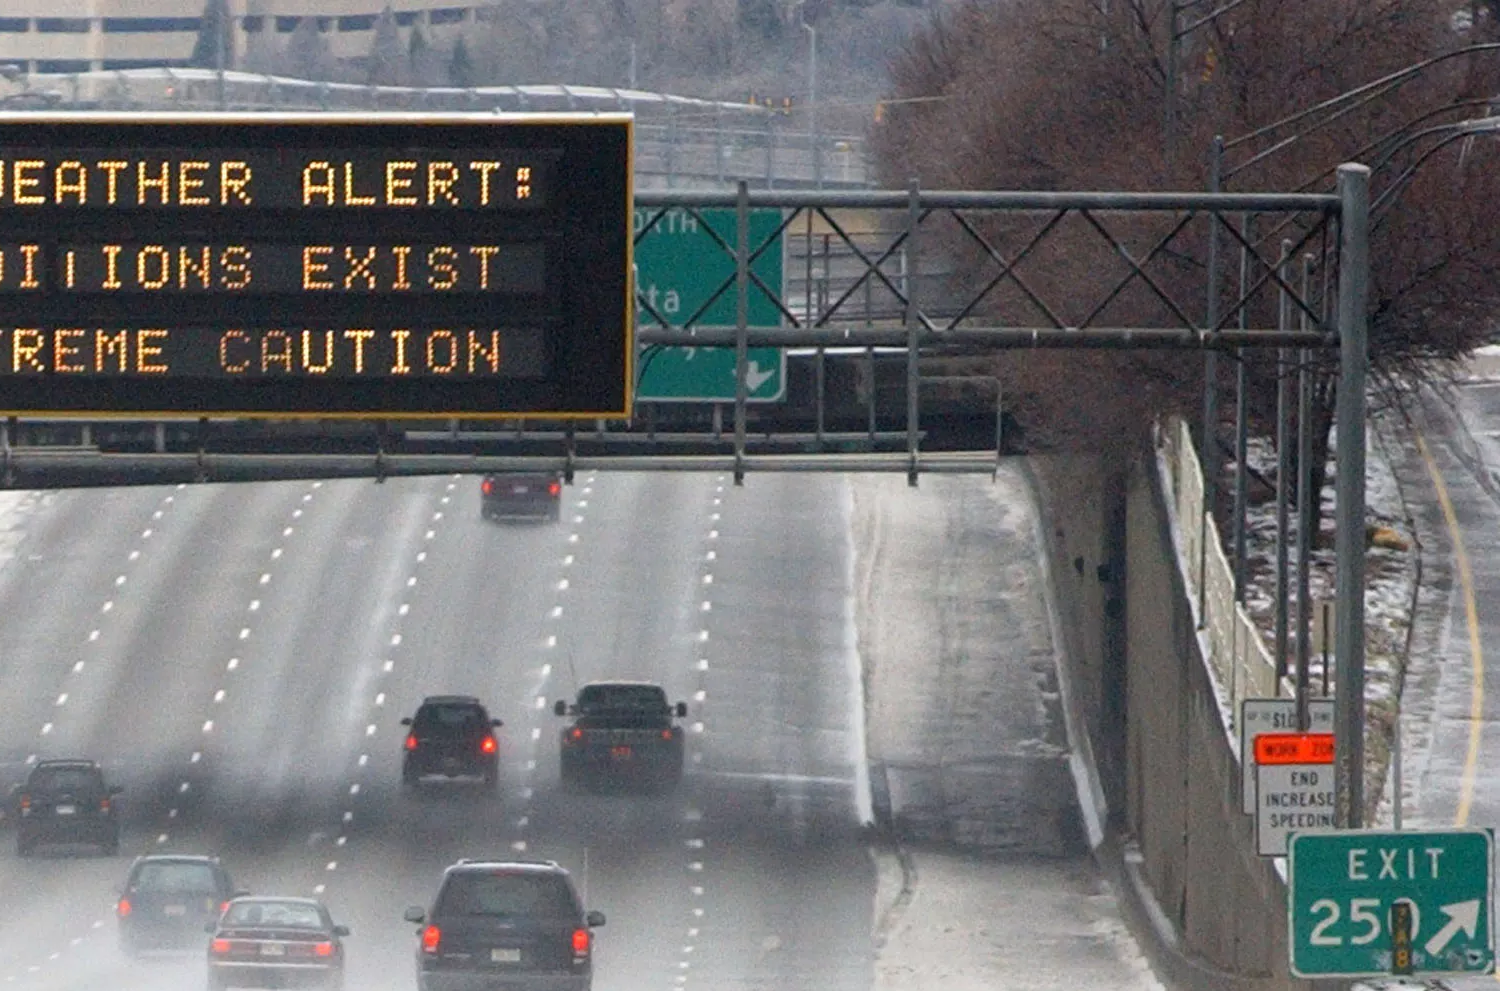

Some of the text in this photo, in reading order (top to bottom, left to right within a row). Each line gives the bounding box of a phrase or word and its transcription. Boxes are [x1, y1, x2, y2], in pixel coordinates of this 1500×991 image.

[302, 161, 532, 206] ALERT:
[302, 246, 500, 290] EXIST
[218, 330, 500, 375] CAUTION
[1291, 771, 1318, 787] END
[1348, 848, 1444, 880] EXIT
